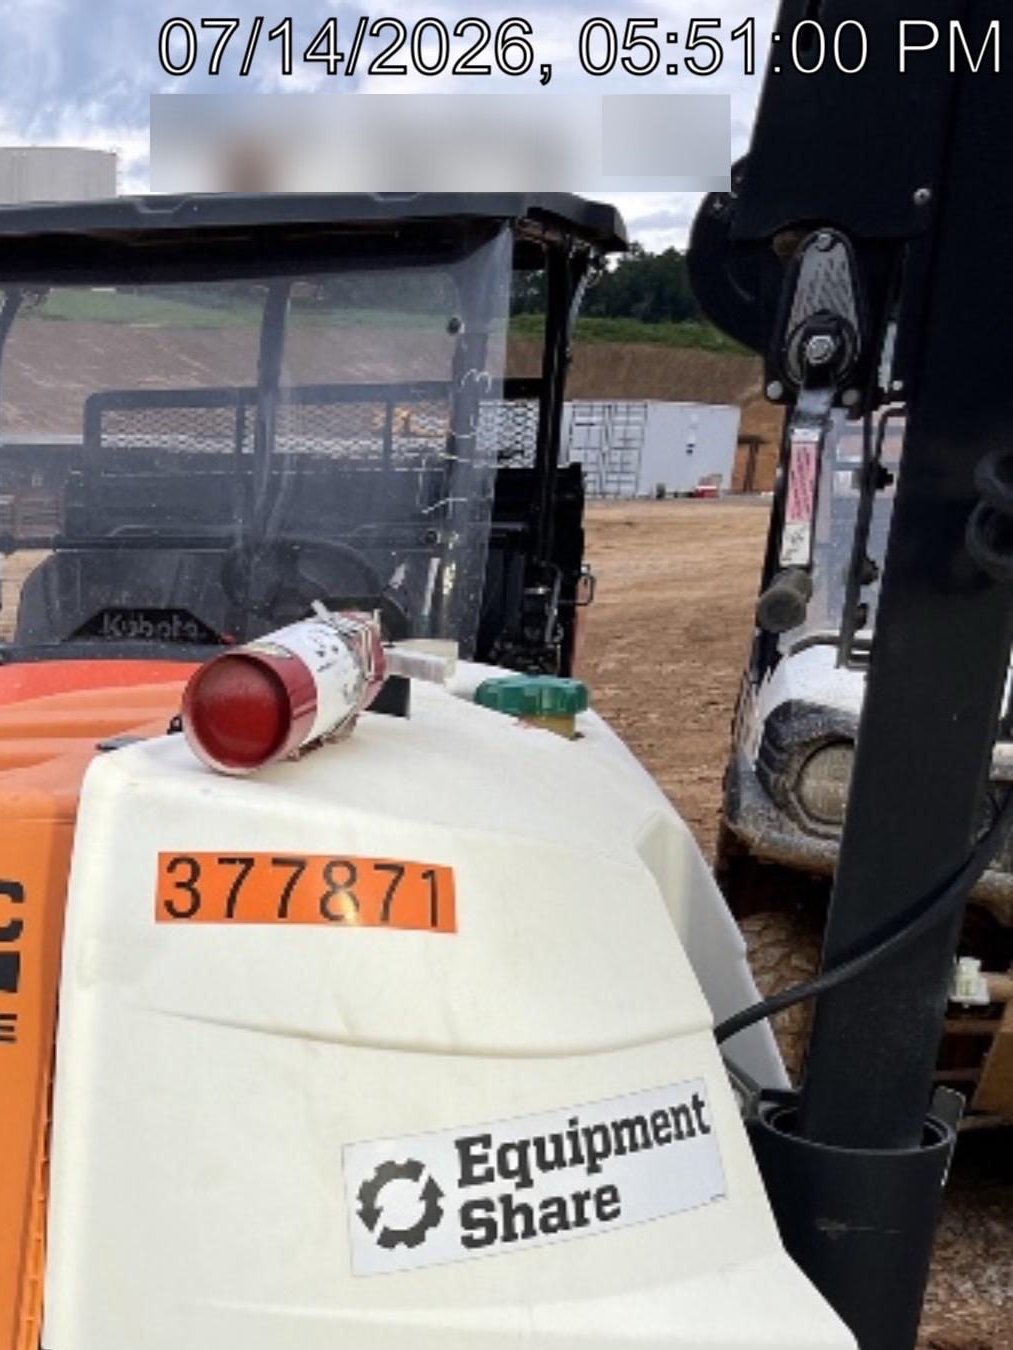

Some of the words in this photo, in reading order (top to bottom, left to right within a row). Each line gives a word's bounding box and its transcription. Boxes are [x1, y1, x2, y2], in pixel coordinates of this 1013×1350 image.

[101, 613, 198, 639] Kubota
[163, 856, 439, 928] 377871
[454, 1092, 711, 1190] Equipment
[458, 1183, 621, 1250] Share
